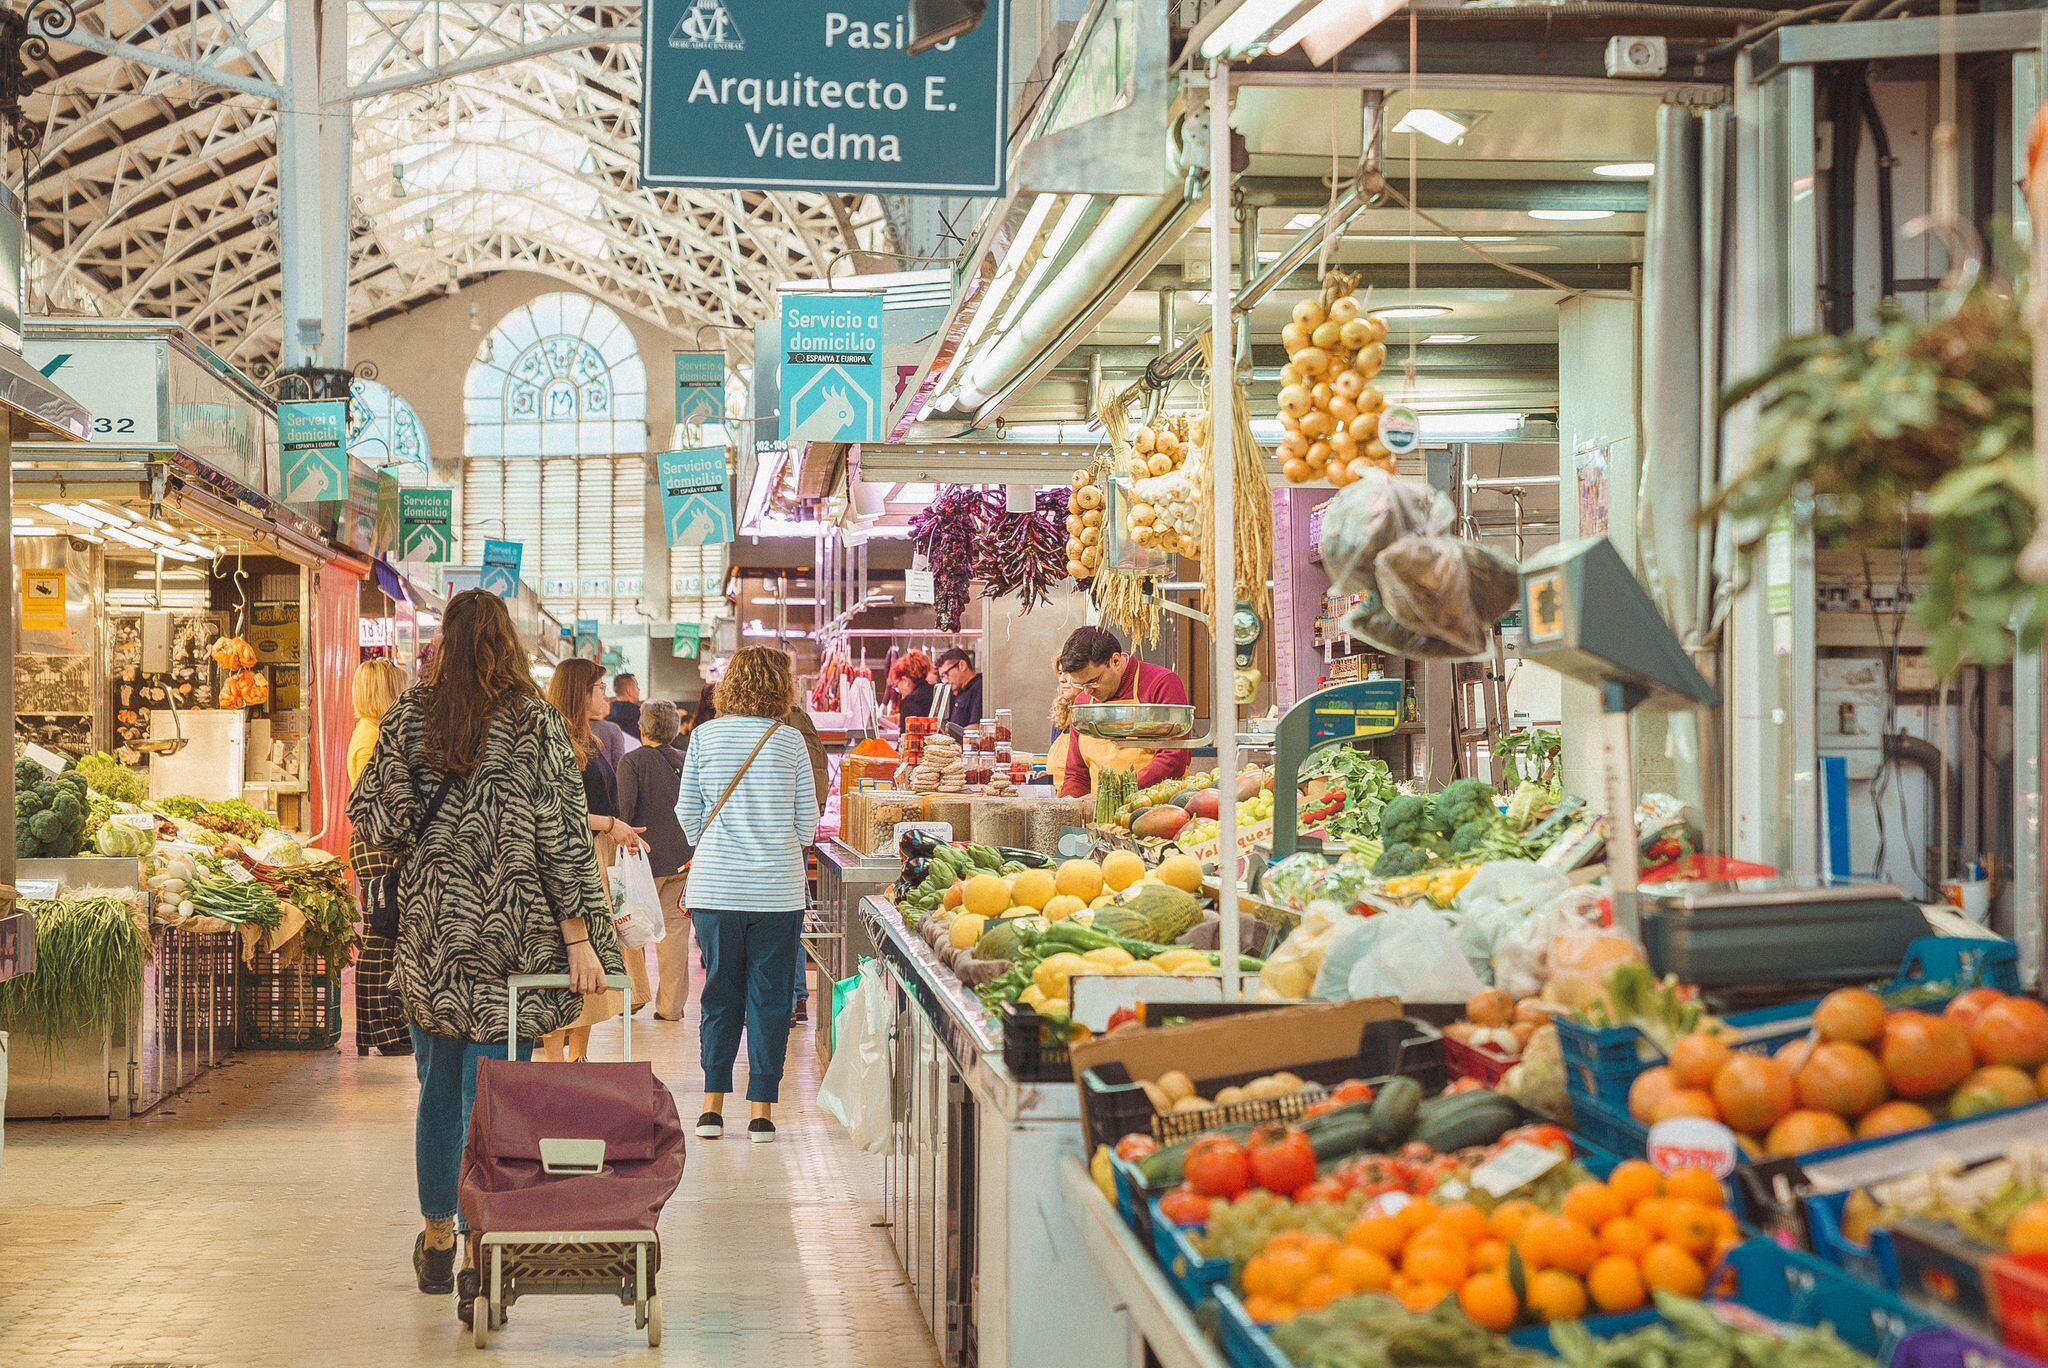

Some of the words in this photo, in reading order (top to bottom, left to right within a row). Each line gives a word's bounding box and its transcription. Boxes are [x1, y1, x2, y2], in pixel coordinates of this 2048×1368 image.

[688, 69, 909, 114] Arquitecto
[924, 76, 958, 112] E.
[745, 122, 902, 162] Viedma
[788, 308, 863, 329] Servicio
[867, 315, 878, 329] a
[790, 331, 876, 351] domicilio
[806, 354, 834, 363] ESPANYA
[841, 355, 867, 363] EUROPA
[93, 417, 135, 434] 32
[287, 412, 326, 427] Servei
[328, 415, 337, 425] a
[287, 427, 338, 441] domicili
[295, 442, 315, 450] ESPANYA
[318, 441, 336, 449] EUROPA
[662, 459, 712, 475] Servicio
[714, 460, 723, 470] a
[666, 472, 723, 489] domicilio
[701, 485, 718, 493] EUROPA
[403, 494, 441, 506] Servicio
[443, 498, 450, 506] a
[404, 506, 448, 517] domicilio
